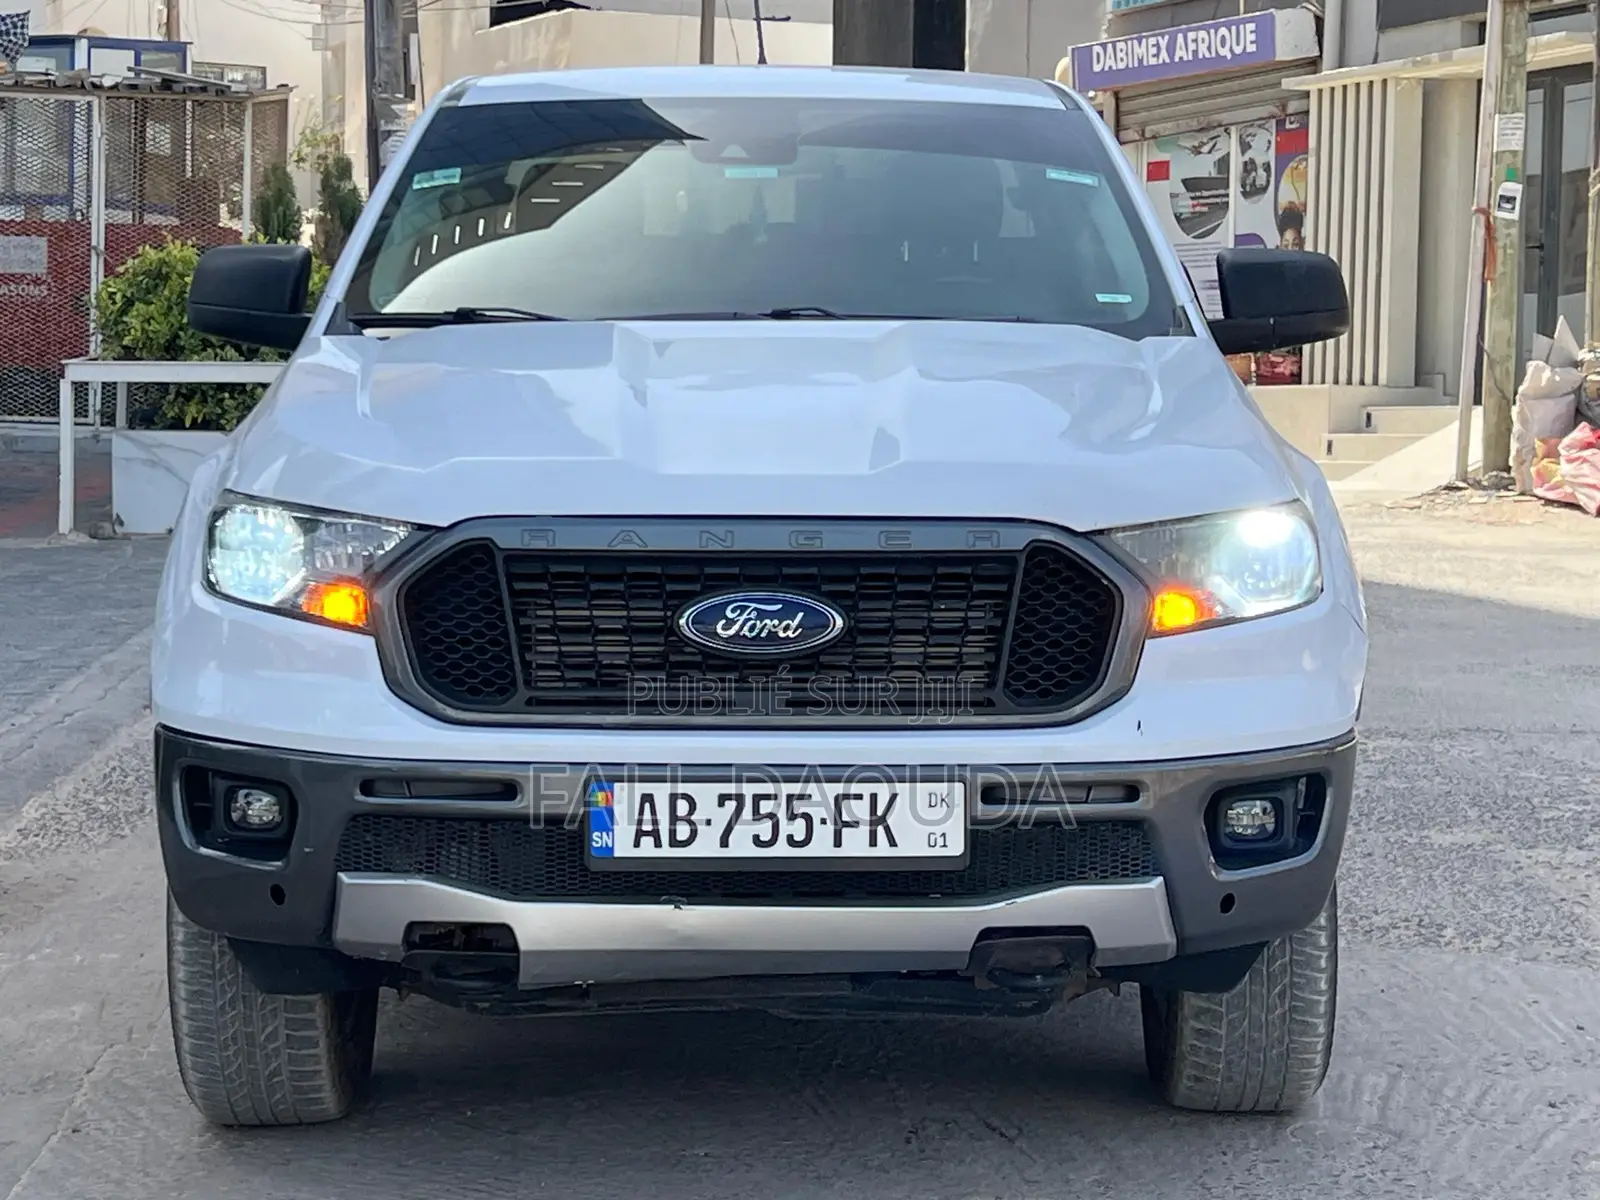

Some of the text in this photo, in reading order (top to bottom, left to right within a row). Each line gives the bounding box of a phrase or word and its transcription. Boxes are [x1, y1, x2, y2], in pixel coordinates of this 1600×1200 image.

[1092, 22, 1257, 73] DABIMEX AFRIQUE
[520, 529, 1000, 549] RANGER
[715, 602, 804, 638] Ford
[928, 792, 950, 808] DK
[591, 831, 613, 848] SN
